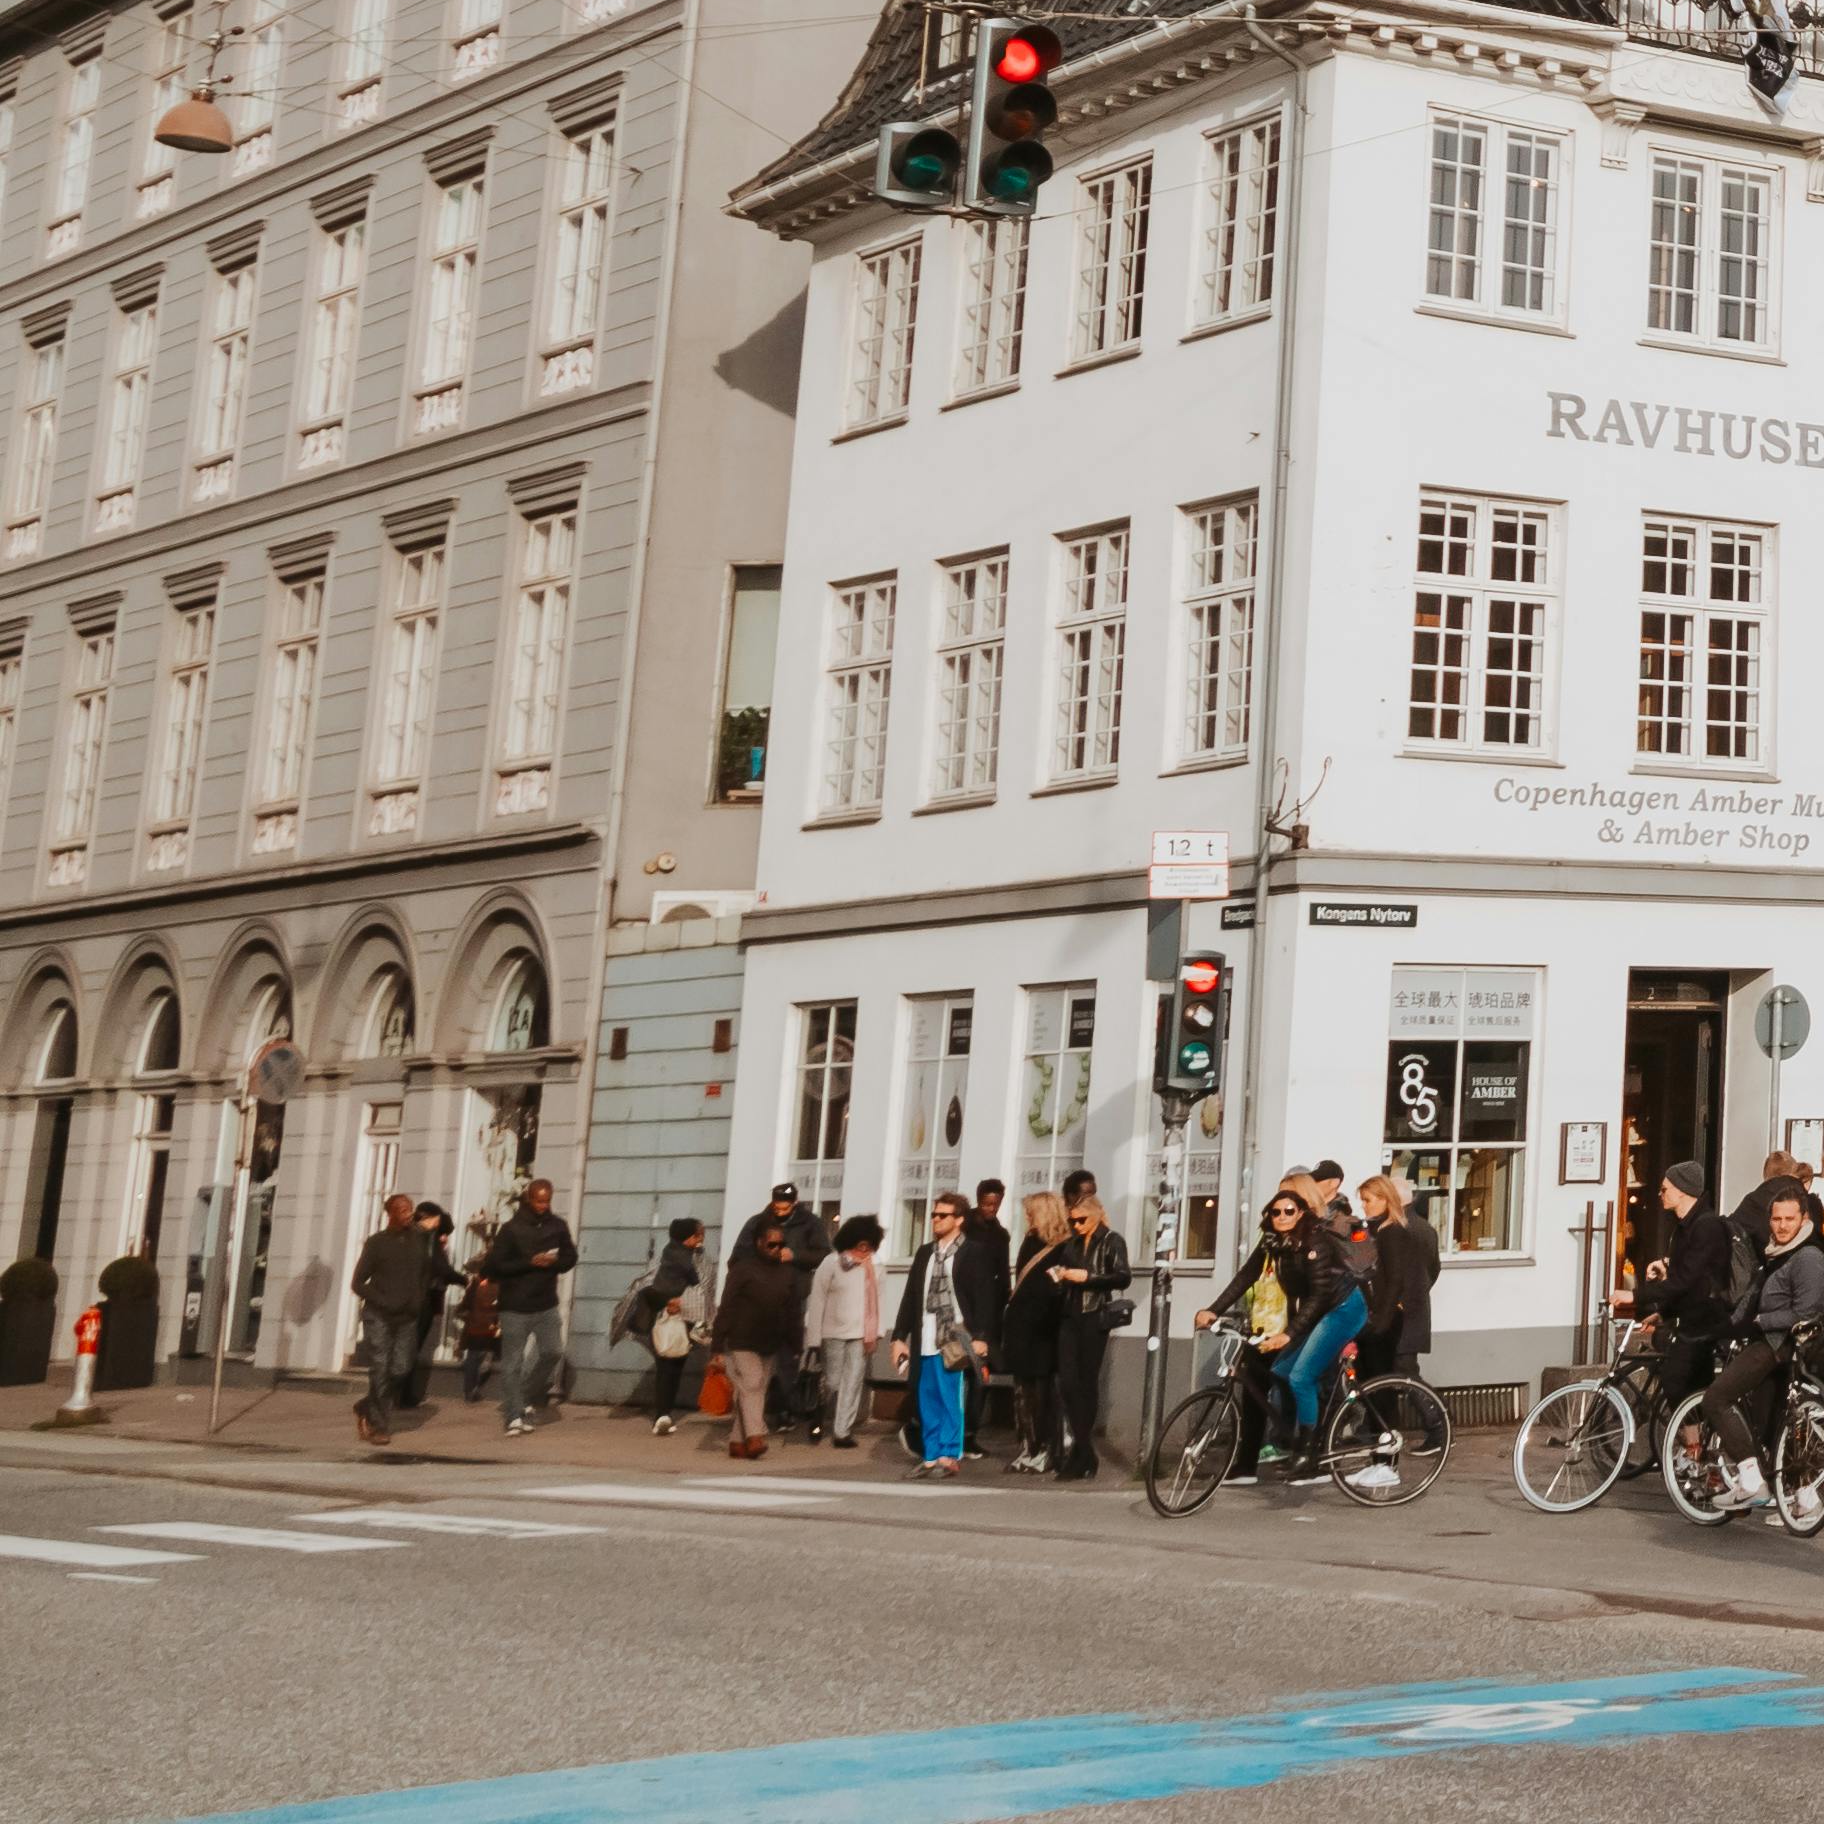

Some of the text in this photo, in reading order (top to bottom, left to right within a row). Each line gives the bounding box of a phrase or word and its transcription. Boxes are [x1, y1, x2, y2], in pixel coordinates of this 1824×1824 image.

[1494, 778, 1680, 816] Copenhagen
[1688, 788, 1783, 816] Amber
[1168, 839, 1214, 856] 12 t
[1597, 819, 1810, 858] & Amber Shop
[1317, 906, 1412, 924] Kongens Nytorv
[1471, 1076, 1518, 1086] HOUSE OF
[1400, 1062, 1439, 1126] 85
[1471, 1087, 1517, 1099] AMBER
